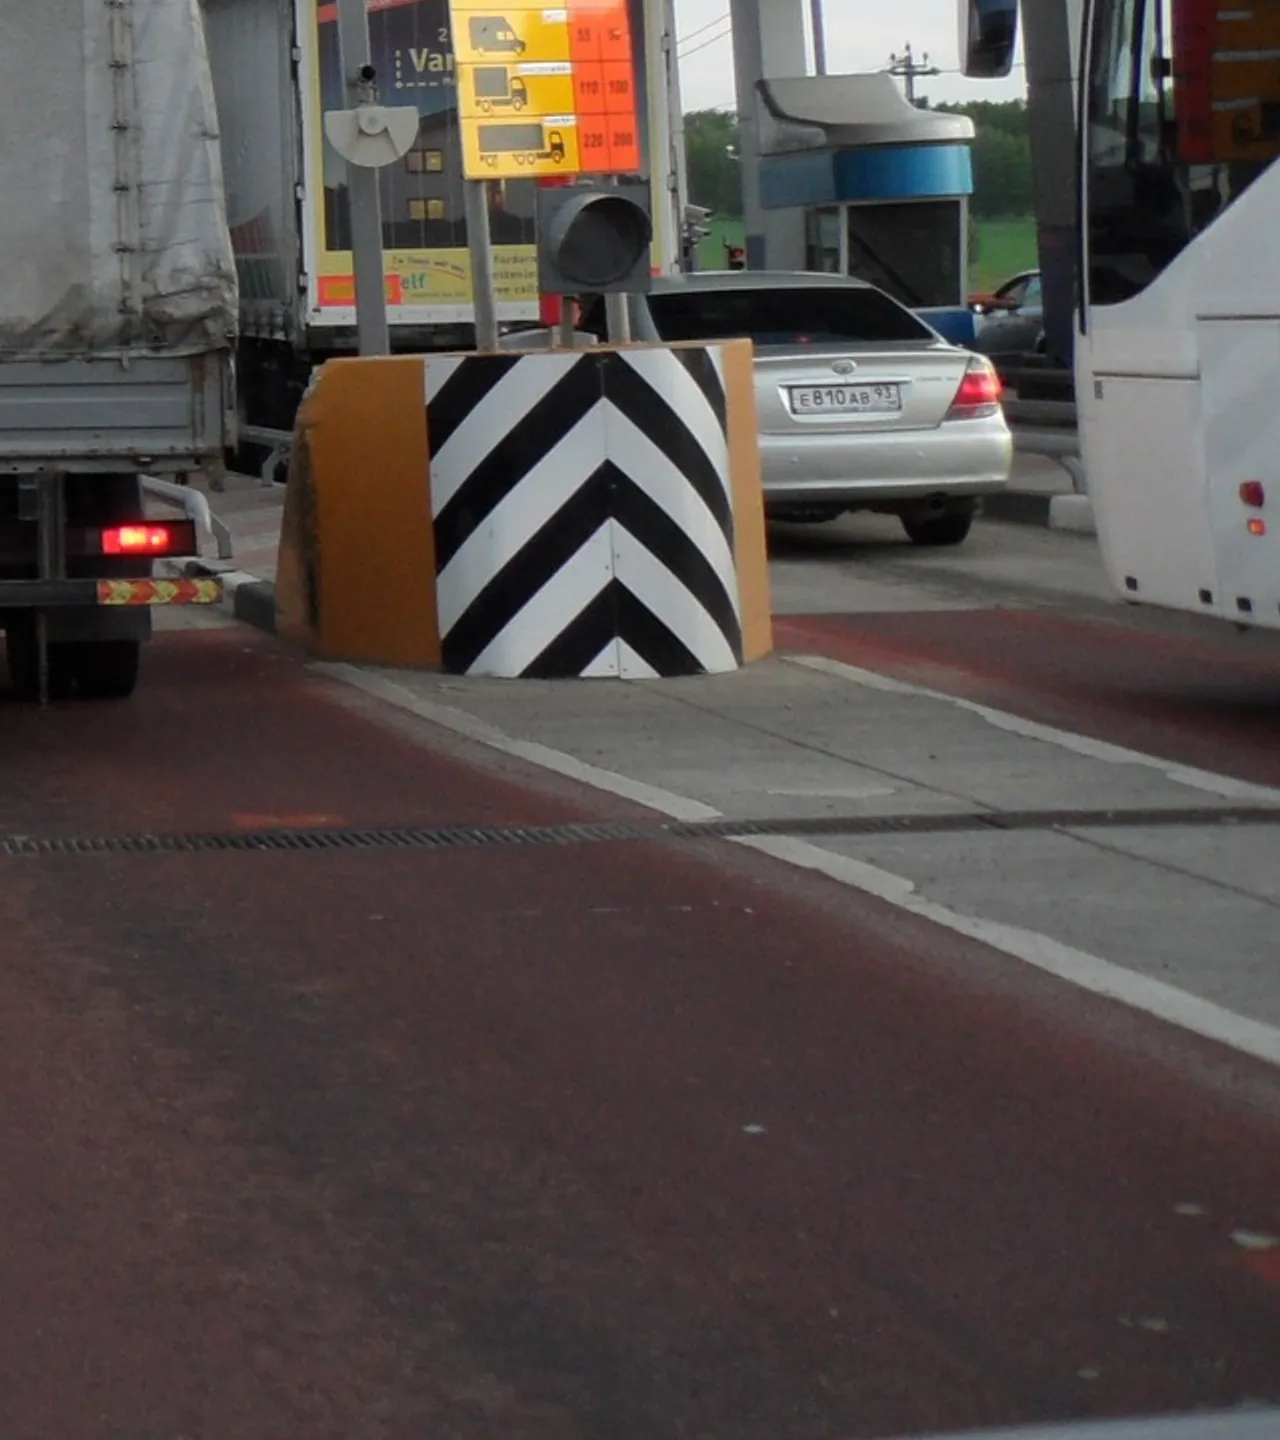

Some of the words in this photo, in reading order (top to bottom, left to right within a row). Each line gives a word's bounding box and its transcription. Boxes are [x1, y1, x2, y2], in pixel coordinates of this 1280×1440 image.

[579, 80, 599, 96] 110
[608, 80, 629, 95] 100
[584, 132, 604, 148] 220
[613, 131, 634, 147] 200
[874, 386, 892, 400] 93
